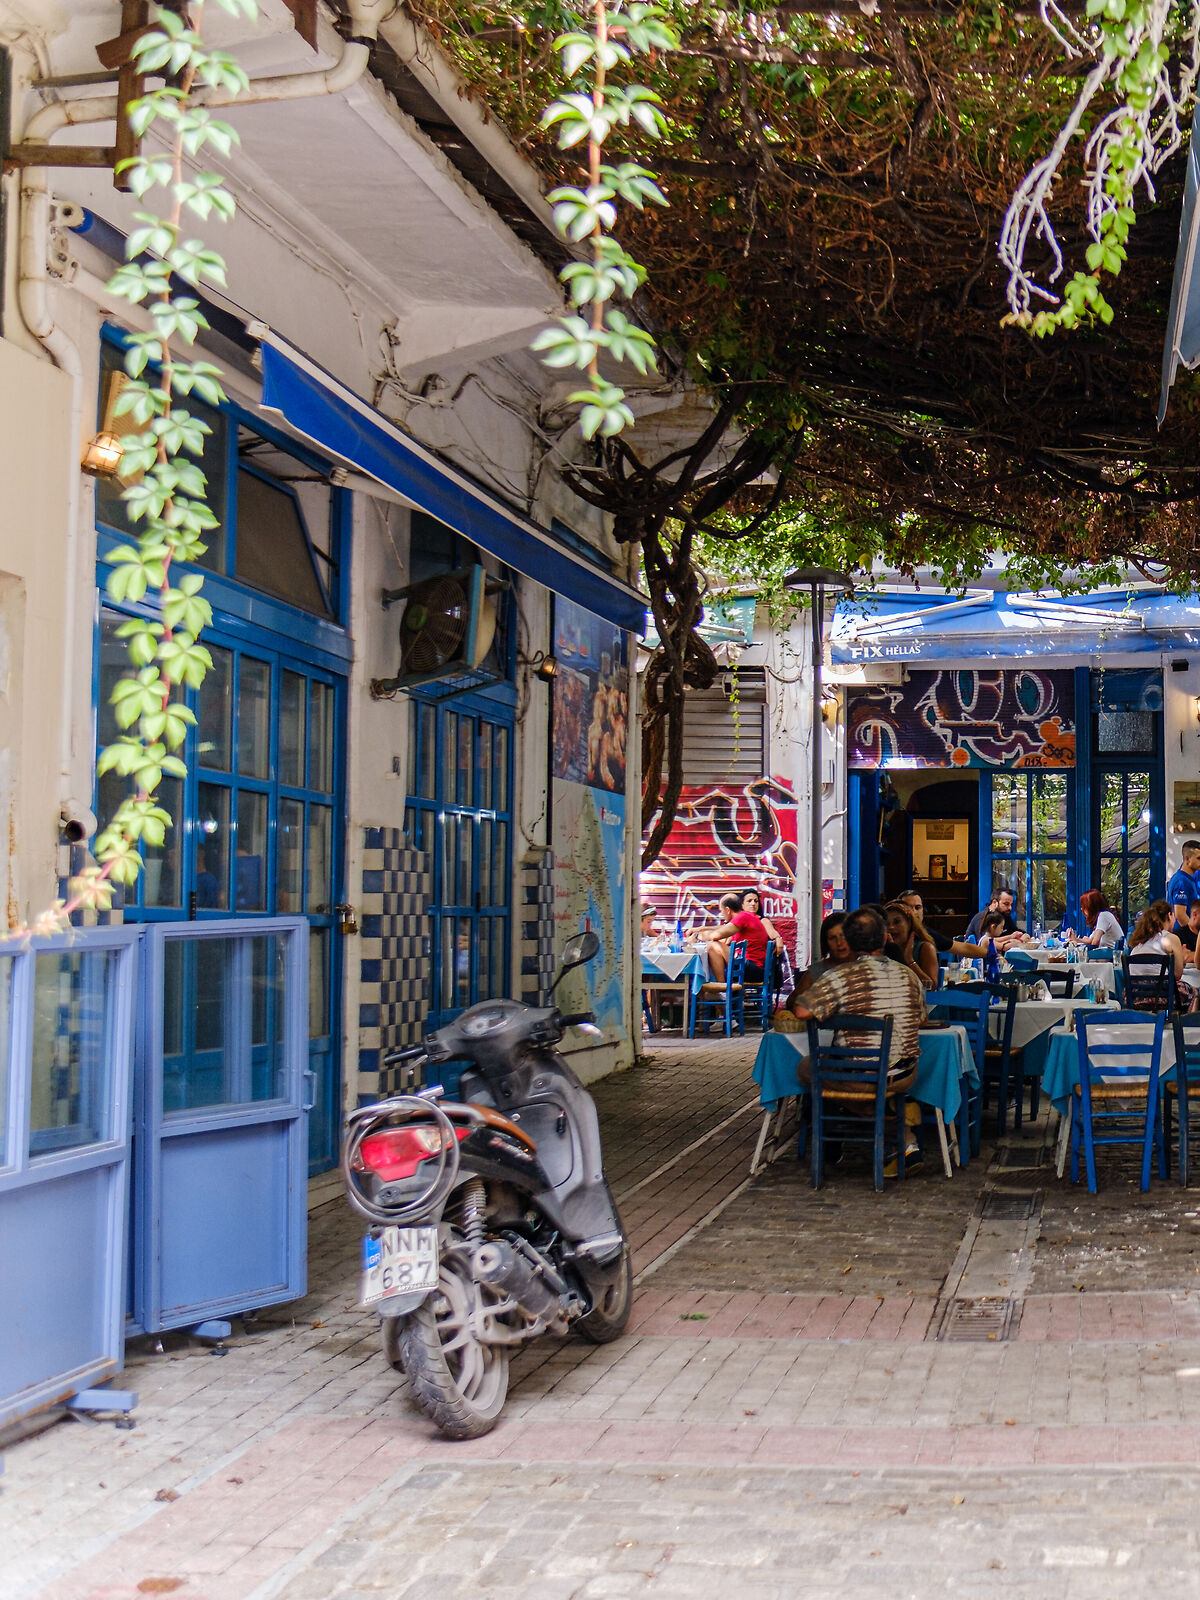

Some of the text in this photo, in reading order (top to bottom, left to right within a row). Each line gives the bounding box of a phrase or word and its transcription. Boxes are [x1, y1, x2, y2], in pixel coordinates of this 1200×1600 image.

[850, 645, 921, 659] FIX HELLAS
[763, 897, 794, 918] 018
[383, 1261, 433, 1290] 687
